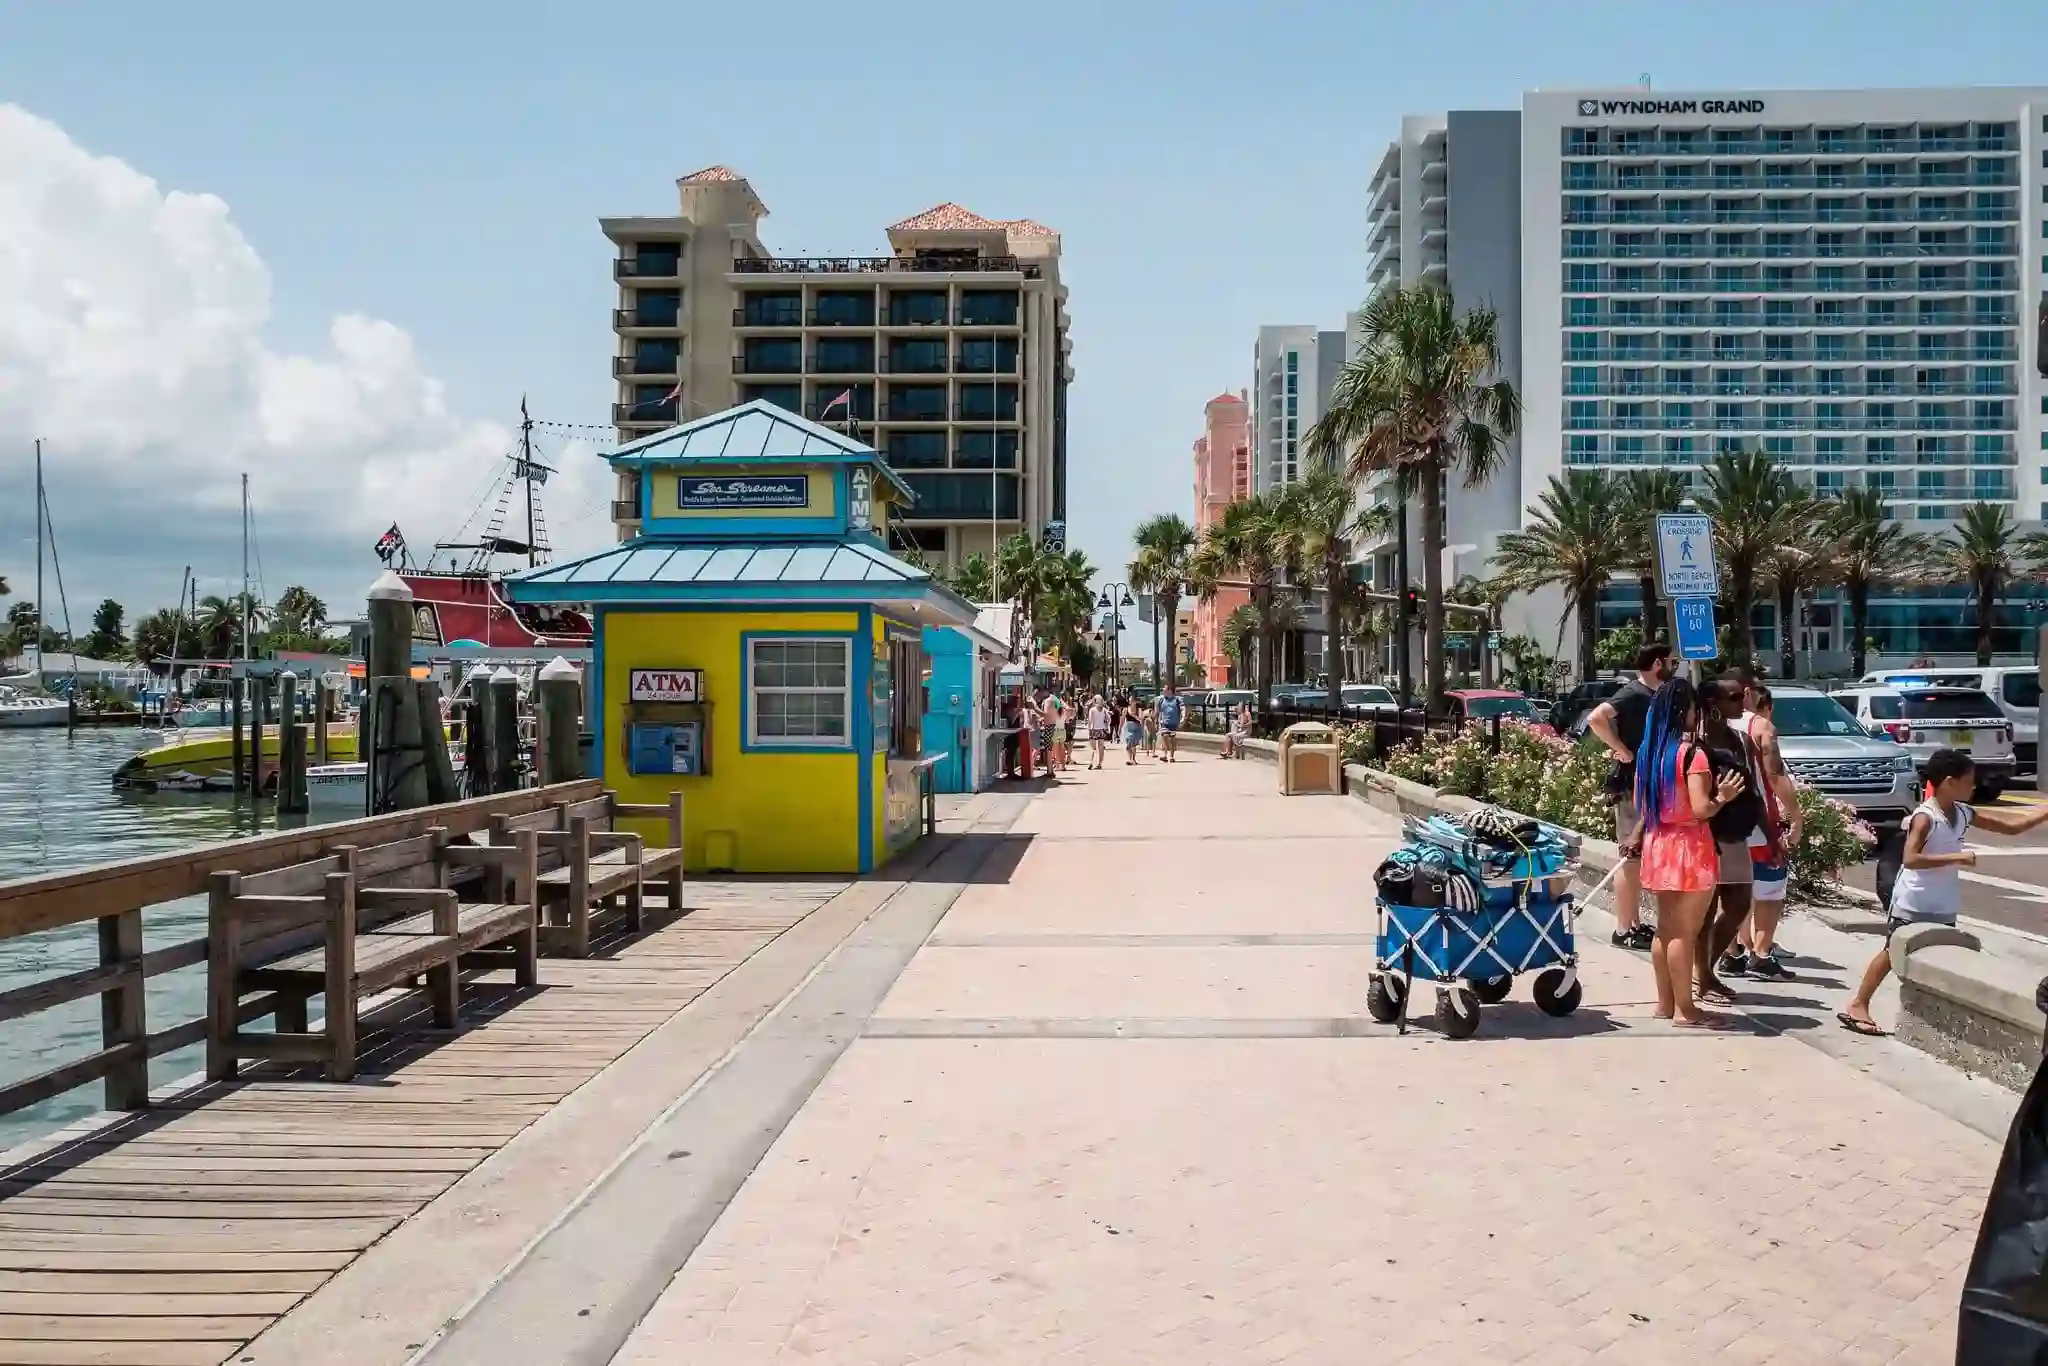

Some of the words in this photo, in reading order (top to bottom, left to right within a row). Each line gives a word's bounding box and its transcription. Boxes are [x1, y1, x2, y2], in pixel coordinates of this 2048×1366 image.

[1601, 100, 1697, 114] WYNDHAM
[1702, 100, 1765, 113] GRAND
[691, 482, 724, 494] Sea
[724, 482, 796, 494] Screamer
[852, 468, 869, 516] ATM
[1667, 527, 1702, 535] CROSSING
[1668, 572, 1689, 581] NORTH
[1691, 571, 1712, 581] BEACH
[1682, 603, 1706, 617] PIER
[1689, 618, 1702, 631] 60
[635, 673, 693, 693] ATM
